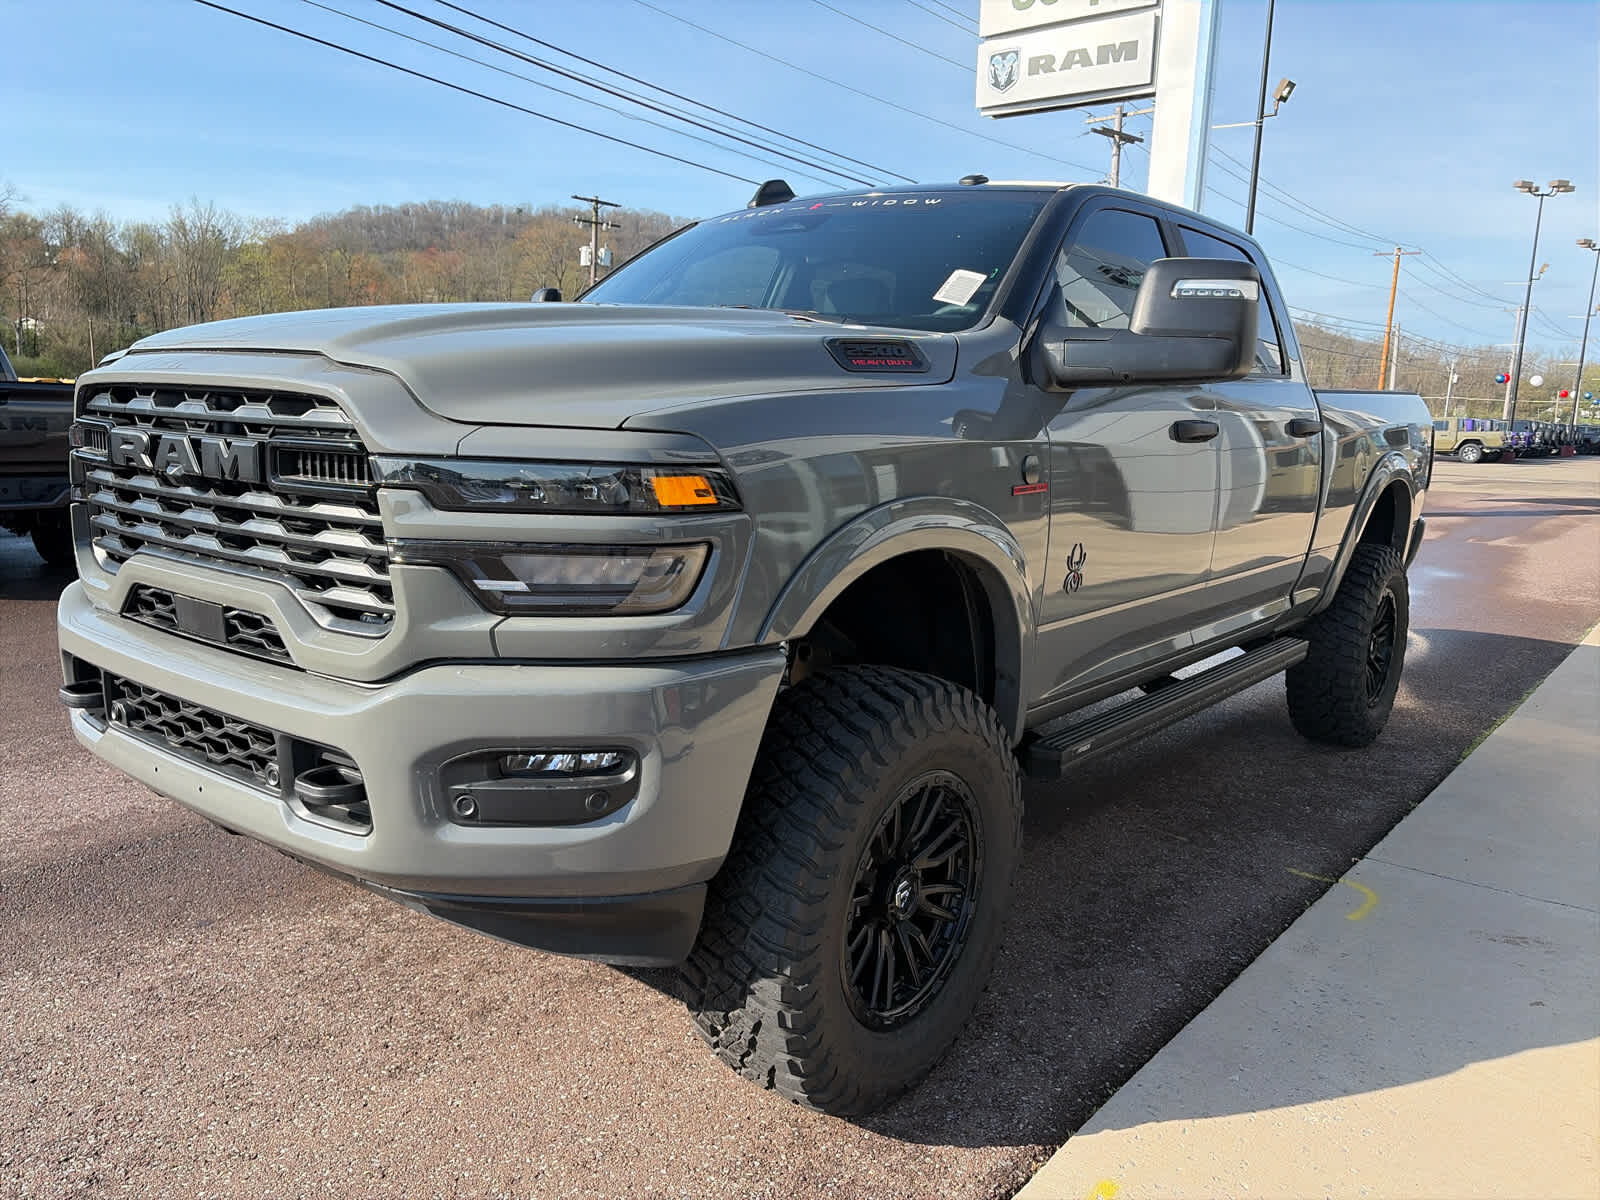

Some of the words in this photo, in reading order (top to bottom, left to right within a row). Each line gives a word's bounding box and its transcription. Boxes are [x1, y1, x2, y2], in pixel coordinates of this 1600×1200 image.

[1027, 40, 1139, 76] RAM
[851, 198, 942, 207] WIDOW
[110, 426, 263, 483] RAM
